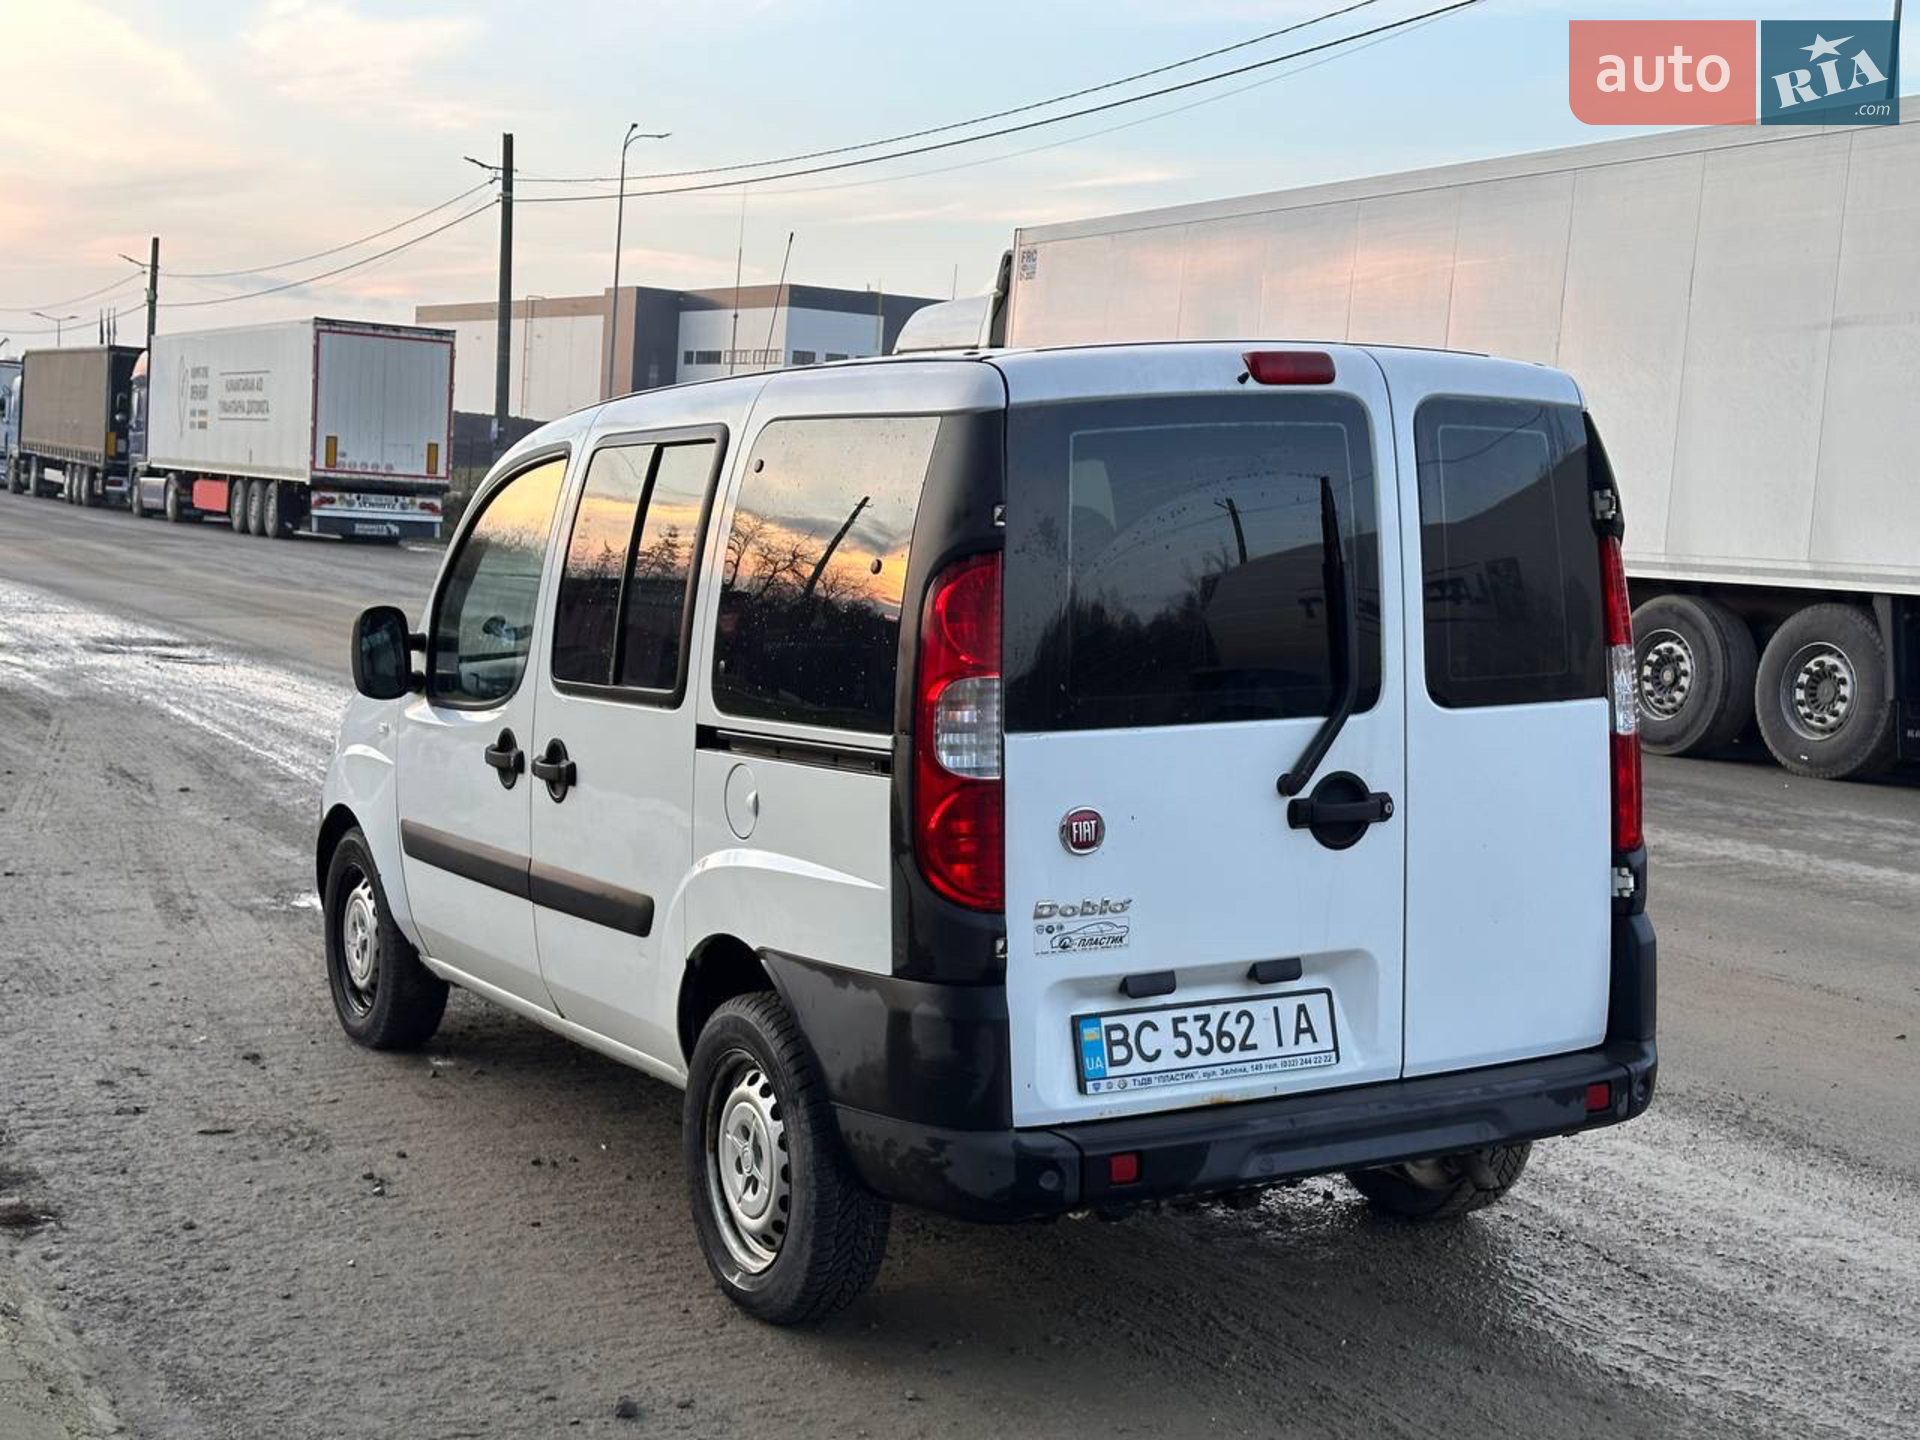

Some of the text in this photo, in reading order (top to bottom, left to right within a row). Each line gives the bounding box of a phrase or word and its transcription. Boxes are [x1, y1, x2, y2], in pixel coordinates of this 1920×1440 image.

[1072, 820, 1098, 843] FIAT
[1105, 1002, 1319, 1068] BC 5362 IA
[1085, 1056, 1105, 1071] UA
